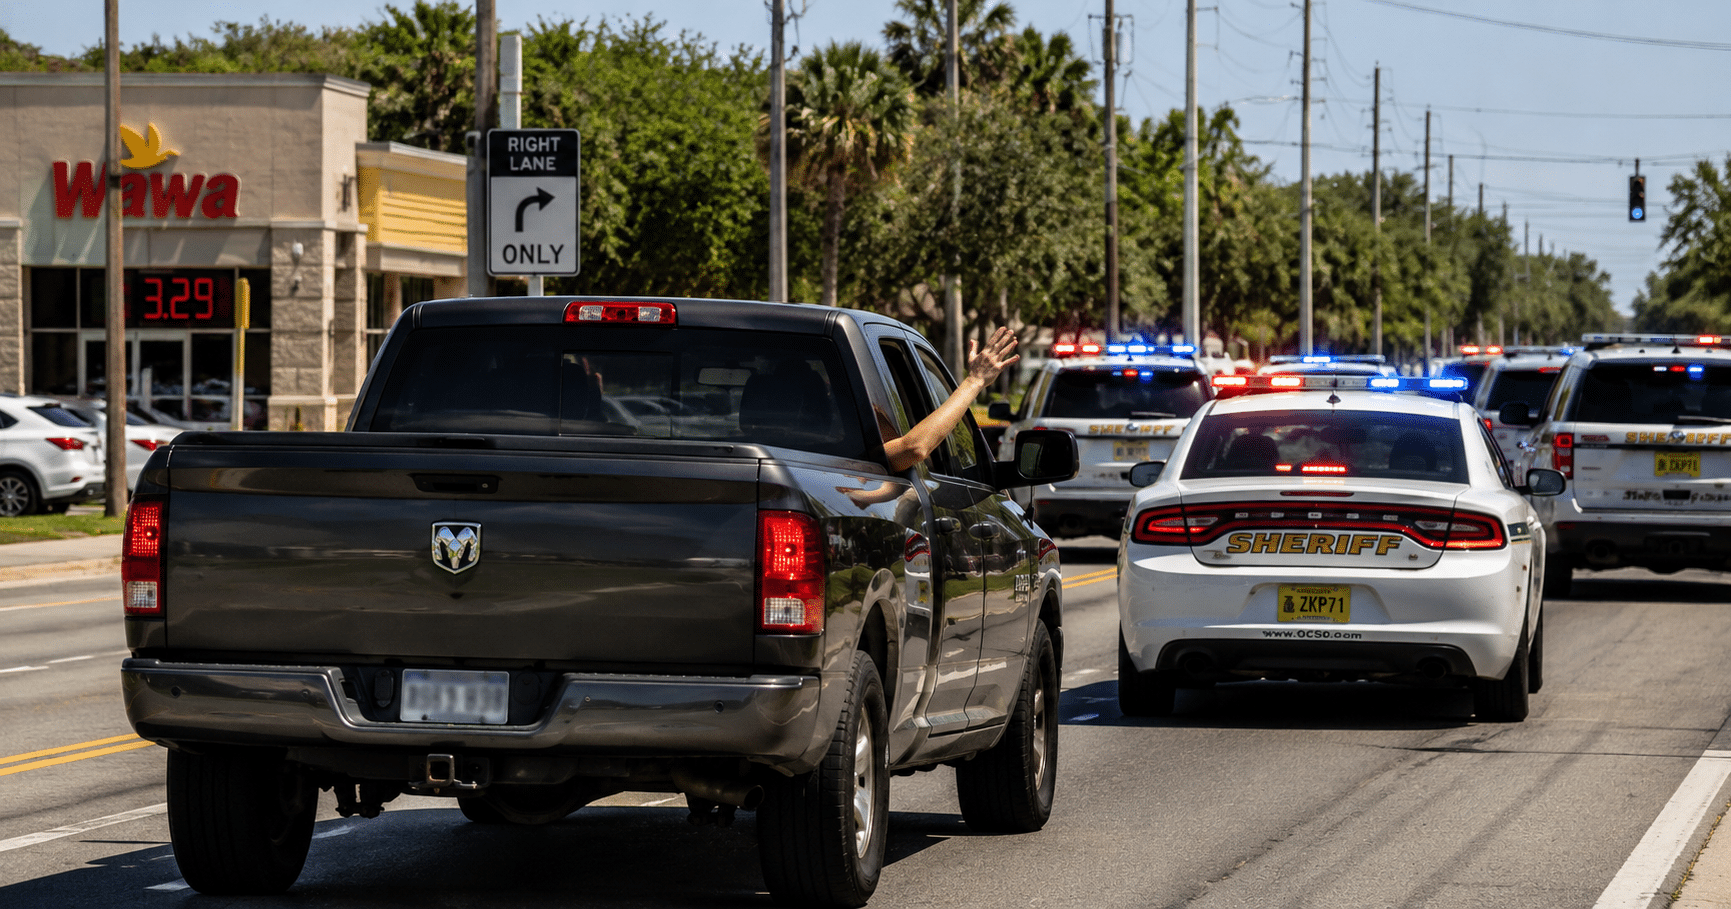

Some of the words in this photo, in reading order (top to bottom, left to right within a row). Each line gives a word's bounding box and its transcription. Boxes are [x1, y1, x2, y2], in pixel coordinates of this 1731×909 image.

[508, 137, 561, 152] RIGHT
[510, 156, 556, 171] LANE
[53, 160, 240, 219] Wawa
[502, 244, 564, 264] ONLY
[144, 278, 213, 319] 3.29
[1226, 533, 1403, 555] SHERIFF
[1299, 596, 1344, 613] ZKP71
